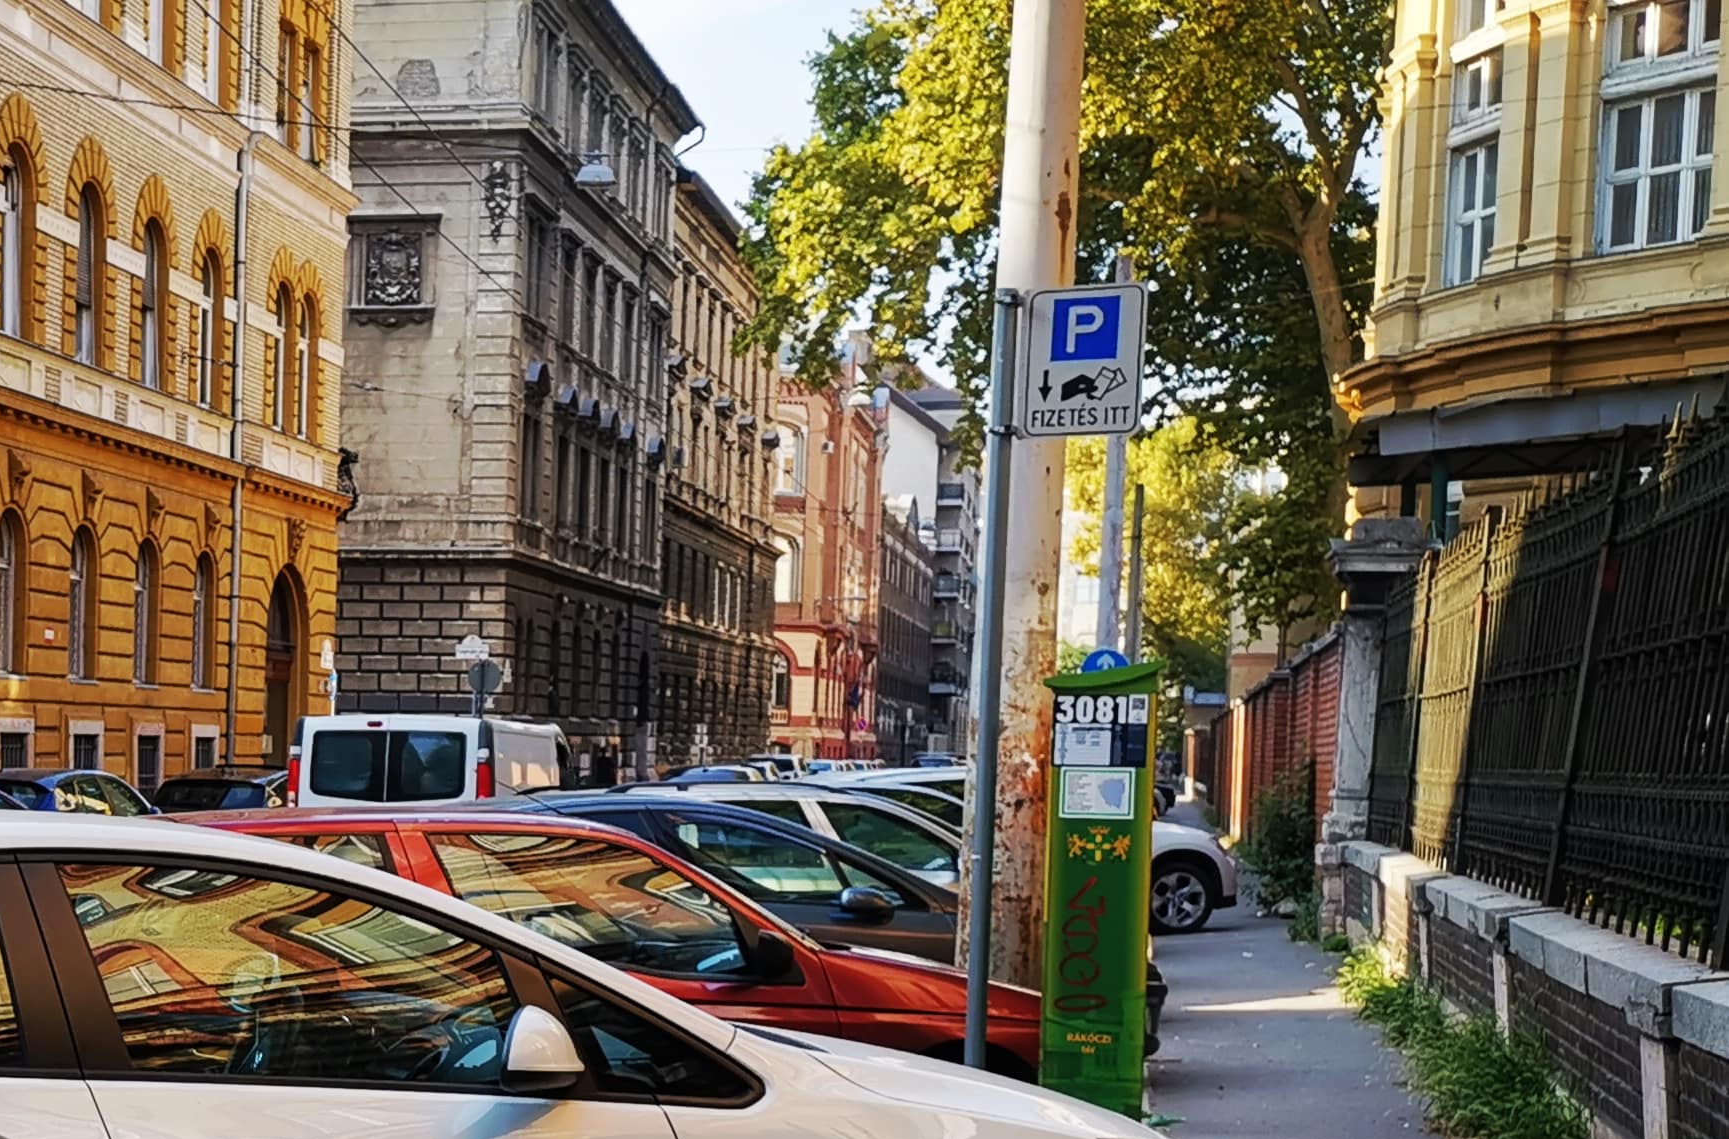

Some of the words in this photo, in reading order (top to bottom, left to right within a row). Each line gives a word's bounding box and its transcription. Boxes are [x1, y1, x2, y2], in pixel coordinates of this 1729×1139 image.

[1065, 304, 1104, 354] P
[1031, 402, 1098, 428] FIZETÉS
[1104, 405, 1131, 425] ITT
[1056, 695, 1128, 724] 3081
